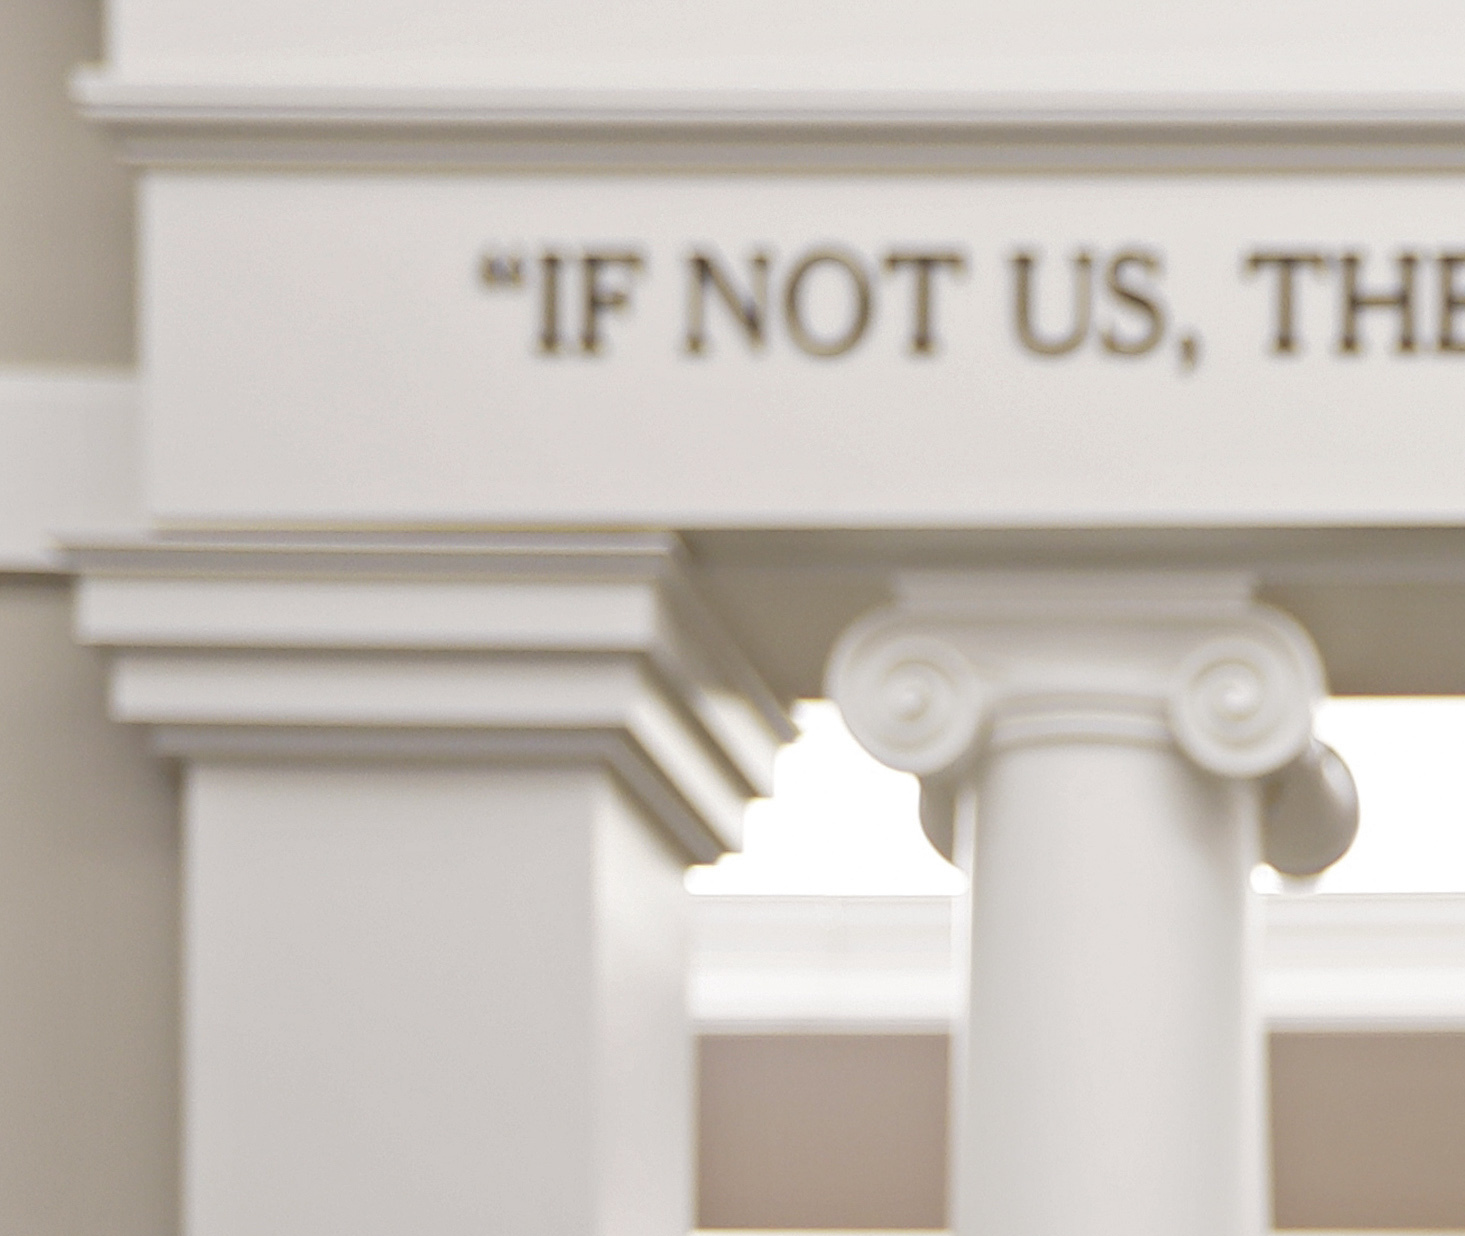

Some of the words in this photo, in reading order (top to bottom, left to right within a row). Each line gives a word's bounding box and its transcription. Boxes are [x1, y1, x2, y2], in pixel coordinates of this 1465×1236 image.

[477, 248, 648, 360] “IF
[682, 248, 970, 361] NOT
[1006, 248, 1202, 372] US,
